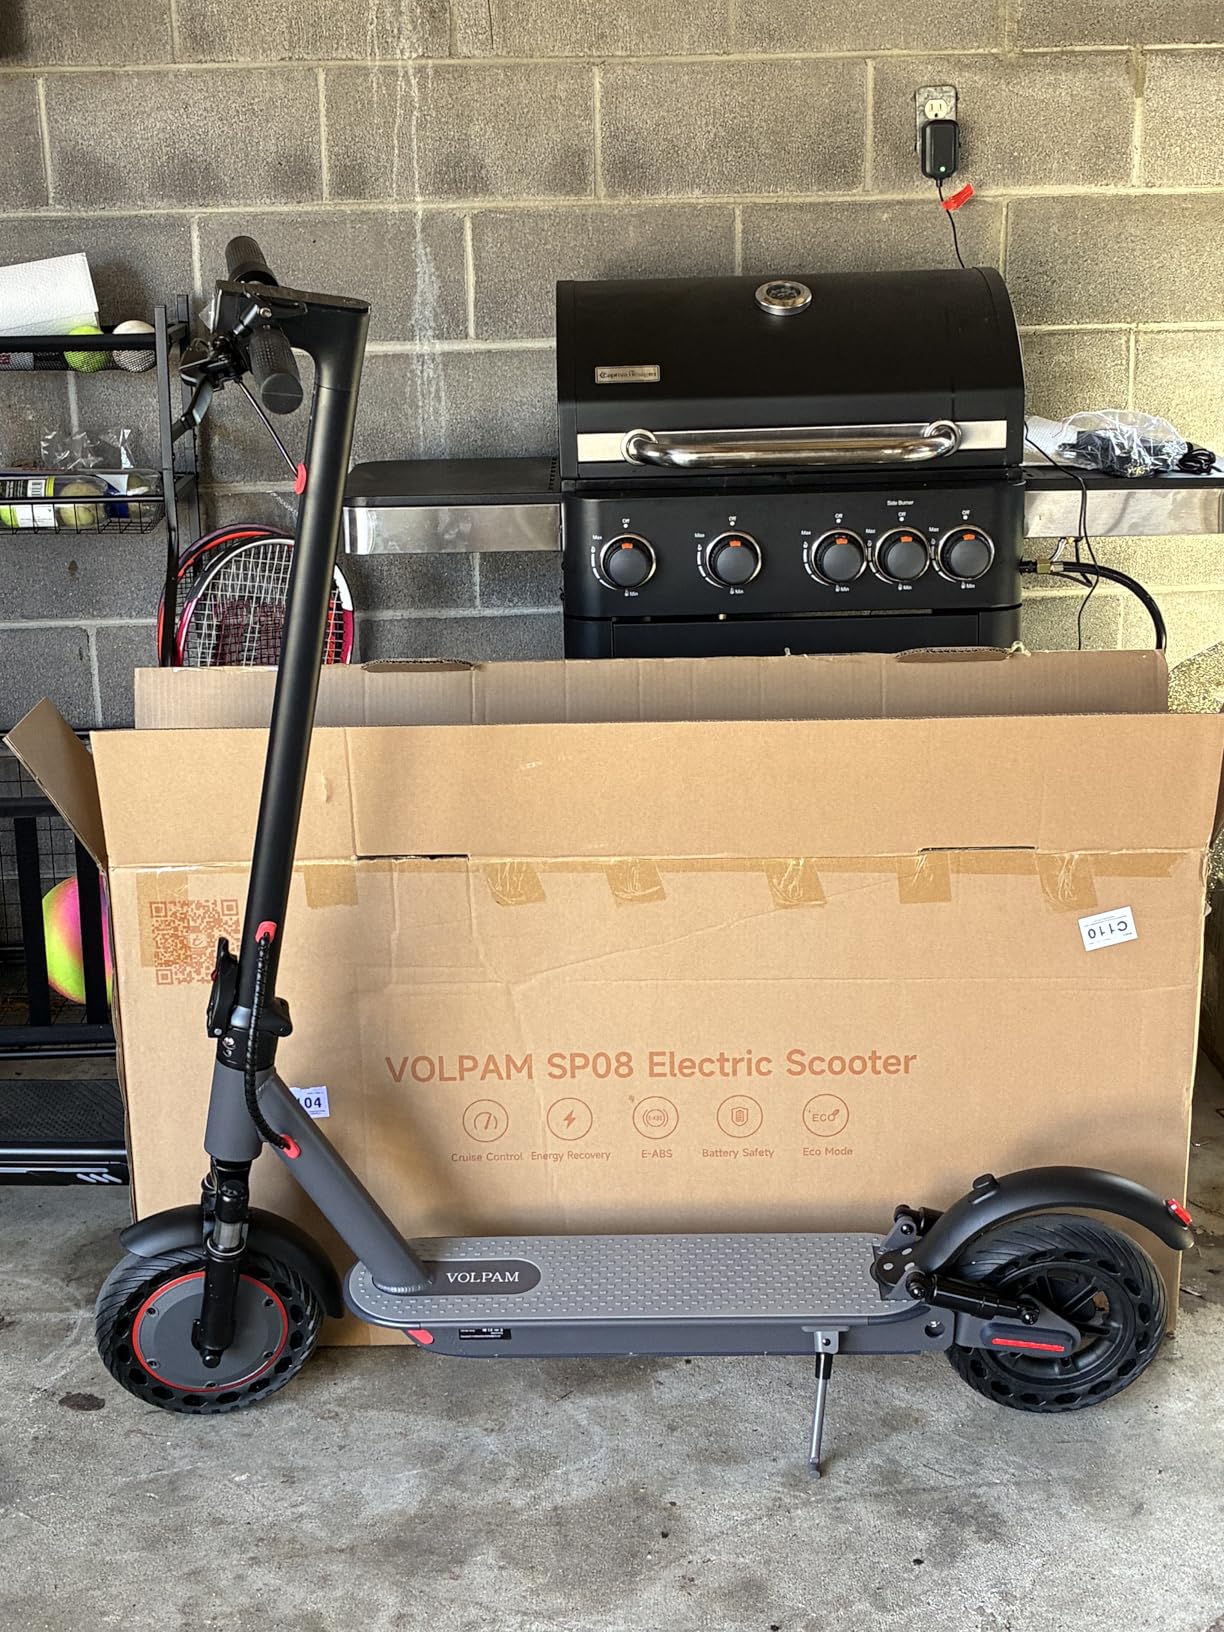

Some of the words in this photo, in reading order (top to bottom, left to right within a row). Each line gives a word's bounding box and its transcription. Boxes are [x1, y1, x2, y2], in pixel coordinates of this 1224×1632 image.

[1087, 920, 1128, 939] C110
[385, 1053, 534, 1083] VOLPAM
[547, 1051, 634, 1080] SP08
[648, 1048, 773, 1078] Electric
[786, 1048, 918, 1077] Scooter
[451, 1152, 482, 1162] Cruise
[486, 1151, 523, 1162] Control
[531, 1151, 565, 1162] Energy
[567, 1150, 611, 1161] Recovery
[641, 1149, 673, 1159] E-ABS
[702, 1148, 739, 1159] Battery
[742, 1147, 775, 1158] Safety
[802, 1147, 822, 1156] Eco
[824, 1146, 853, 1156] Mode
[446, 1271, 520, 1283] VOLPAM
